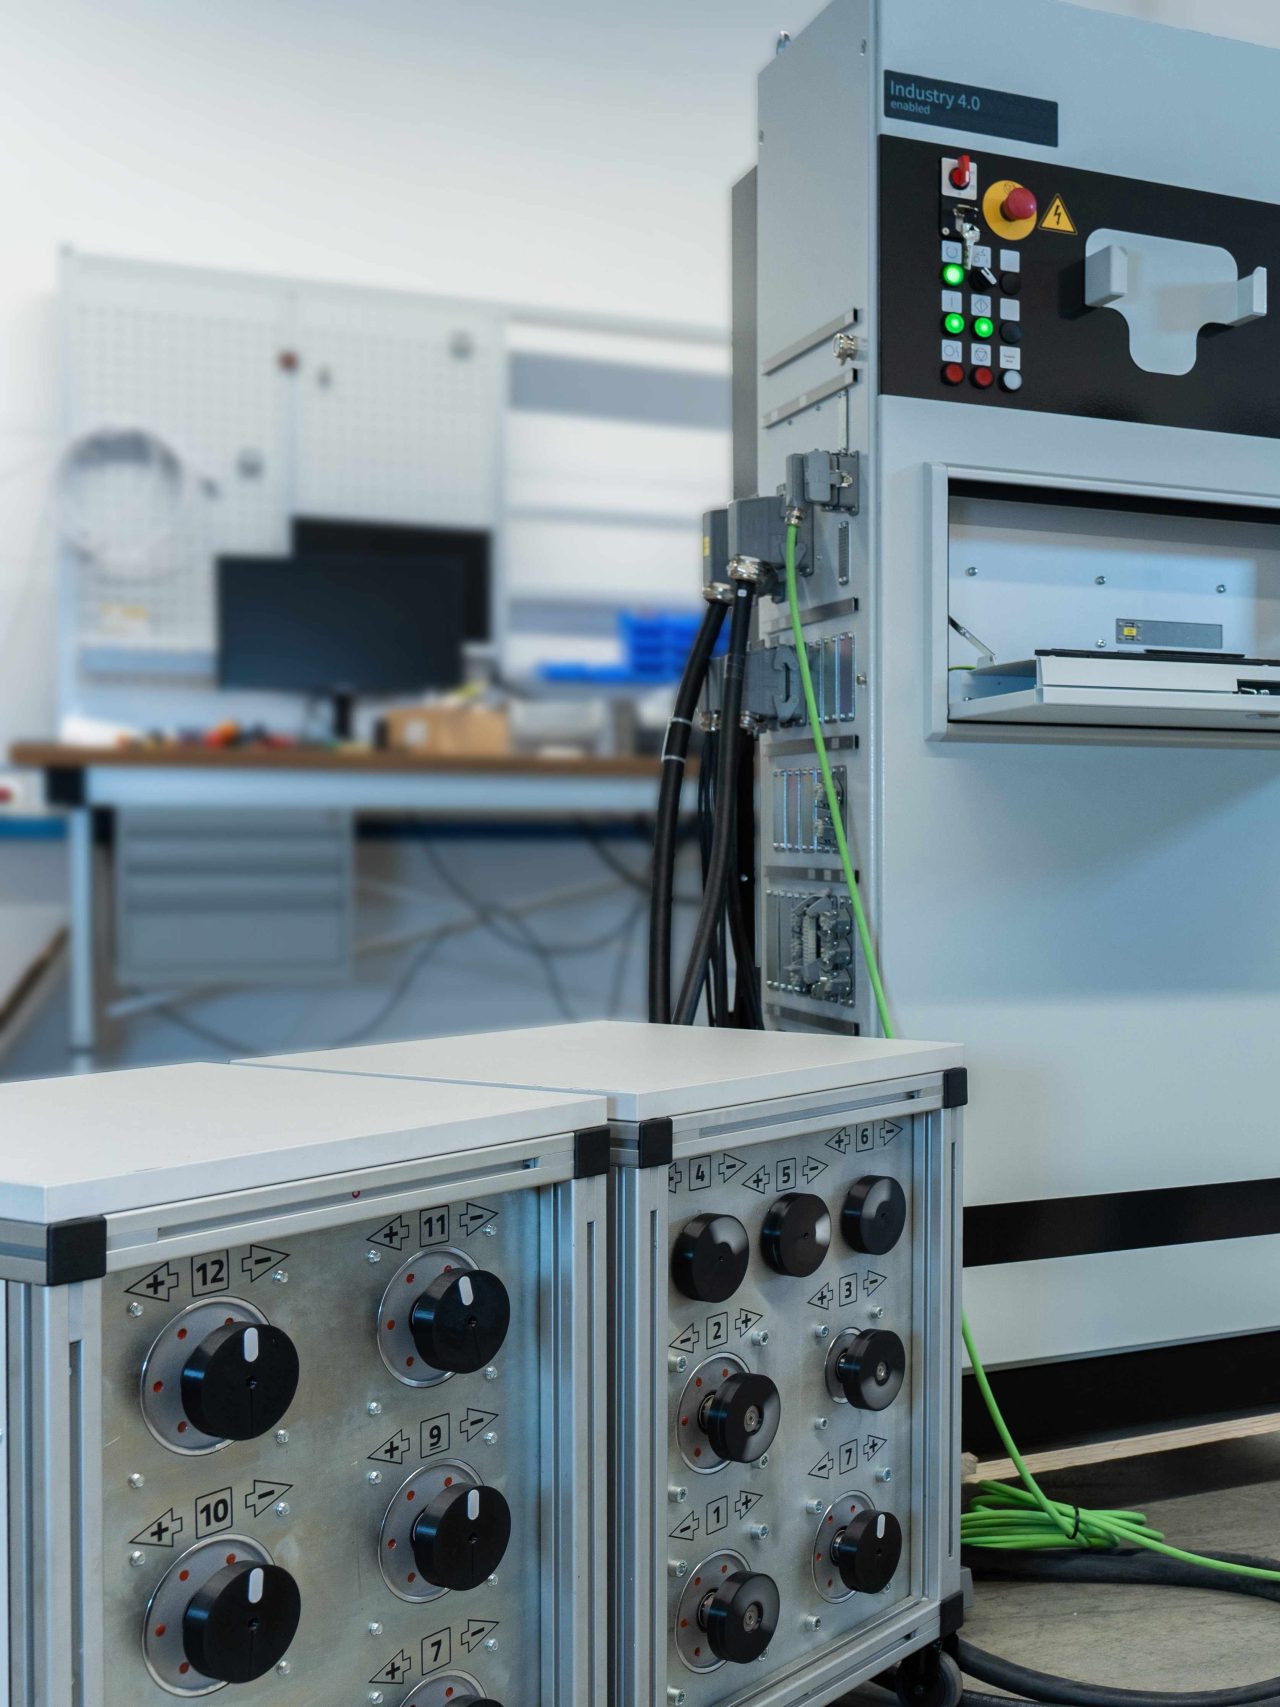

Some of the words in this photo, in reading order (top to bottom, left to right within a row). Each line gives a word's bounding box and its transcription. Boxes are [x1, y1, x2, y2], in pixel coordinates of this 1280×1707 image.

[890, 80, 955, 110] Industry
[957, 93, 981, 111] 4.0
[890, 100, 931, 115] enabled
[860, 1127, 869, 1146] 6
[695, 1163, 706, 1182] 4
[782, 1165, 791, 1184] 5
[423, 1213, 446, 1238] 11
[195, 1259, 225, 1286] 12
[844, 1281, 853, 1299] 3
[712, 1321, 722, 1341] 2
[428, 1424, 442, 1450] 9
[844, 1447, 853, 1466] 7
[199, 1498, 229, 1528] 10
[712, 1505, 721, 1524] 1
[430, 1638, 442, 1663] 7
